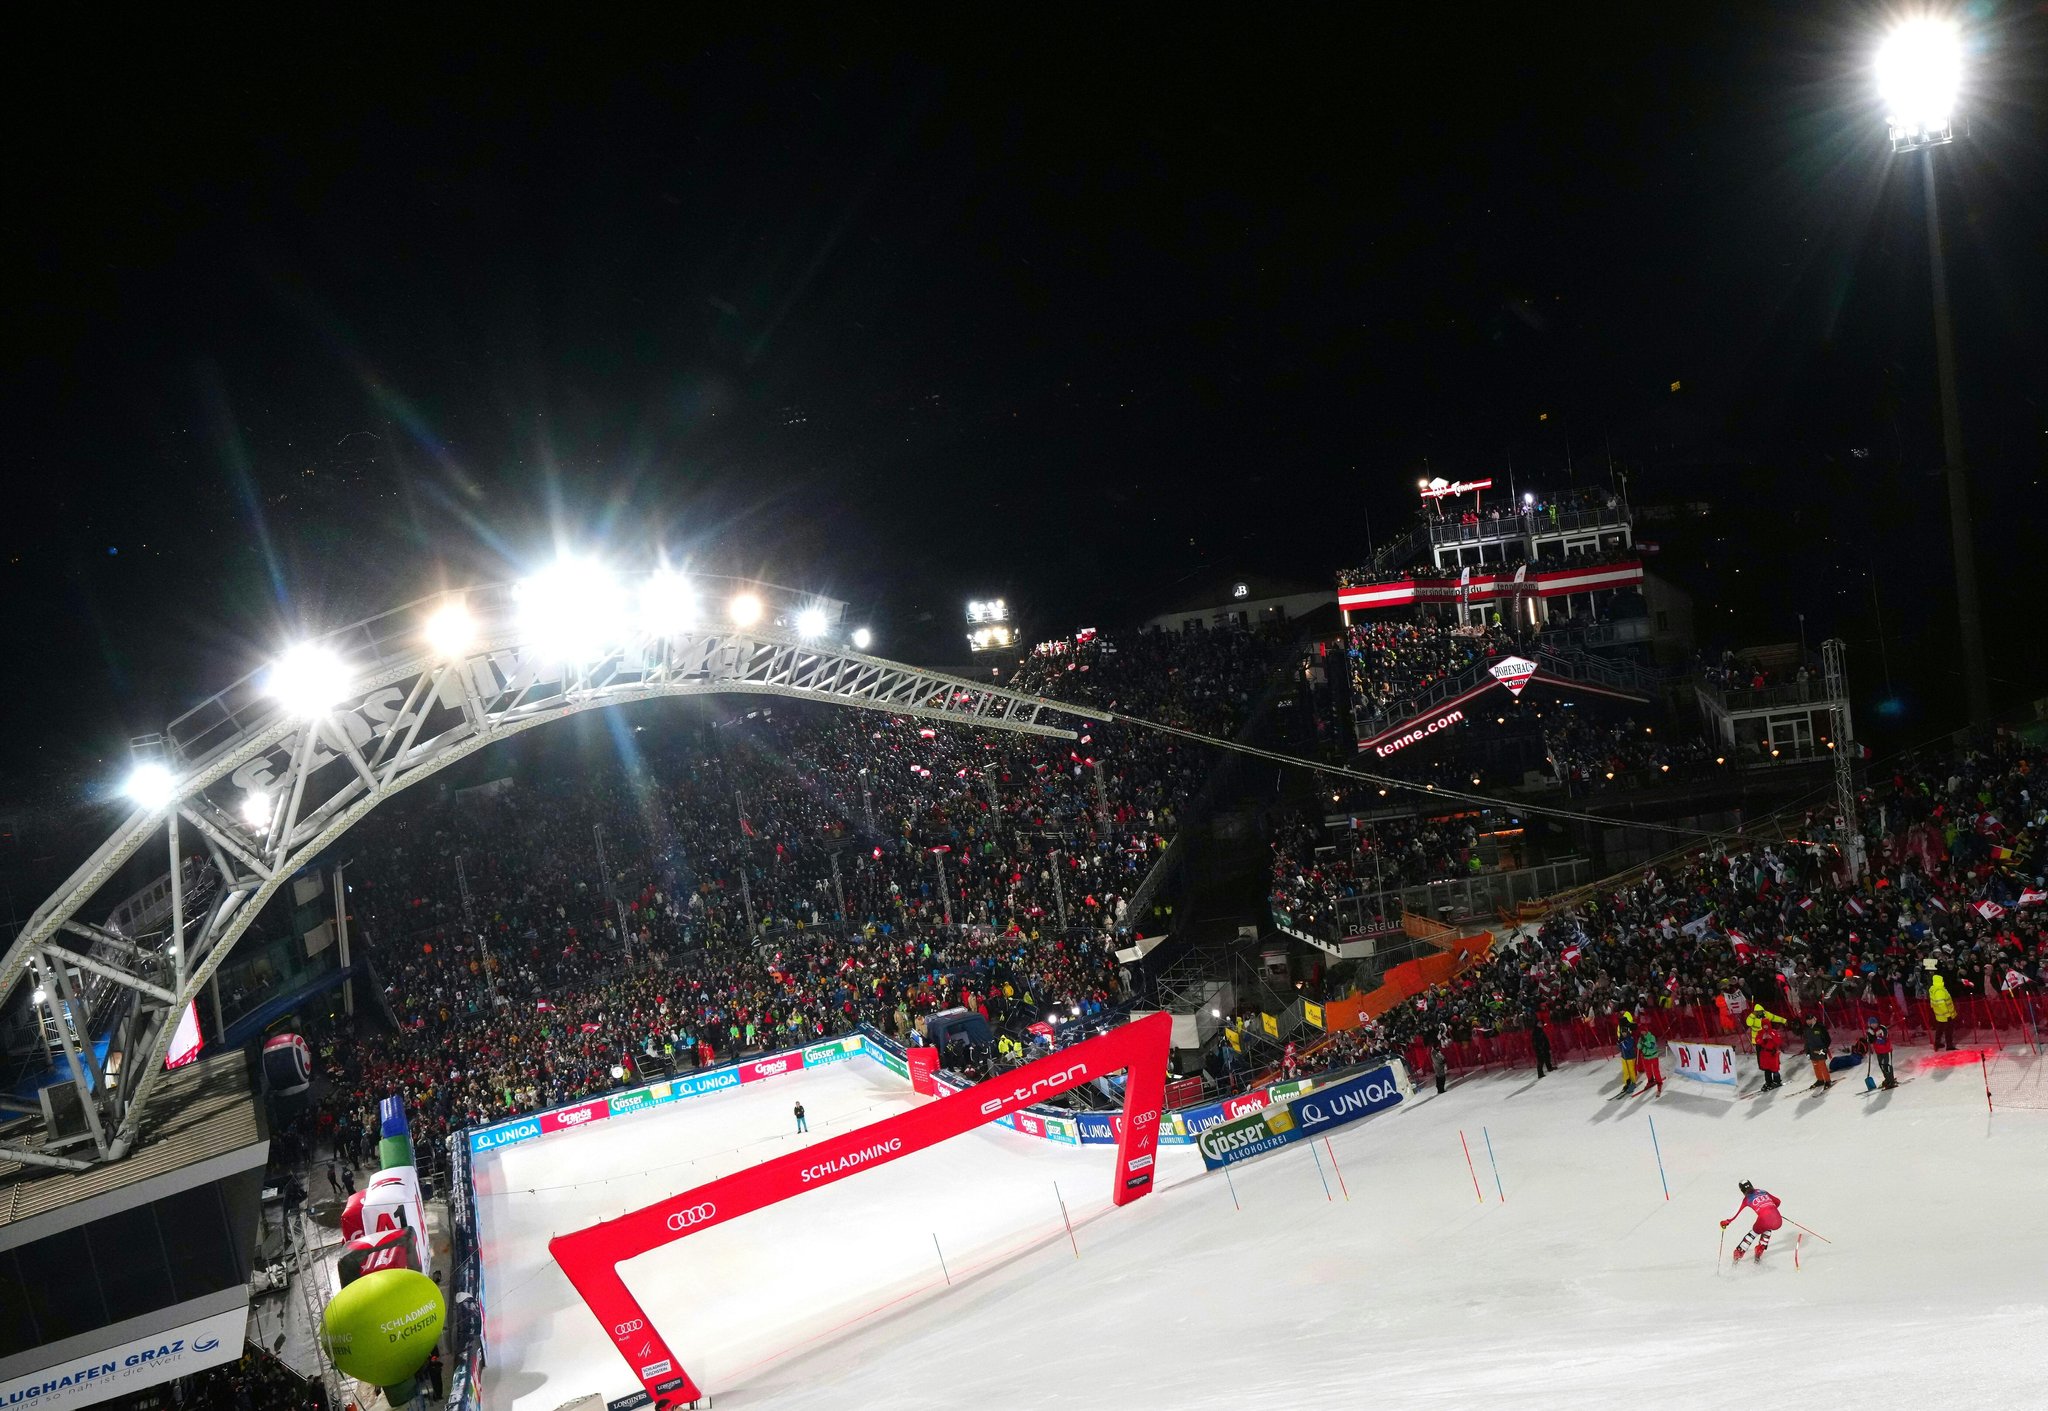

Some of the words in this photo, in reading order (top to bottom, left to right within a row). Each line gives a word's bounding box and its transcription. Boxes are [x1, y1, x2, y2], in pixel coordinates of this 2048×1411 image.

[1494, 661, 1535, 678] HOHENHAUS
[1376, 710, 1464, 758] tenne.com
[697, 1075, 738, 1092] UNIQA
[981, 1062, 1087, 1114] e-tron
[1330, 1079, 1397, 1116] UNIQA
[495, 1124, 539, 1144] UNIQA
[1088, 1124, 1114, 1138] UNIQA
[1200, 1121, 1265, 1160] Gösser
[801, 1137, 902, 1183] SCHLADMING
[1228, 1135, 1287, 1162] ALKOHOLFREI
[380, 1300, 437, 1333] SCHLADMING
[389, 1313, 437, 1343] DACHSTEIN
[0, 1361, 117, 1408] LUGHAFEN
[124, 1339, 185, 1368] GRAZ
[46, 1391, 61, 1403] so
[68, 1381, 93, 1395] nah
[100, 1373, 116, 1386] ist
[123, 1364, 144, 1378] die
[613, 1393, 647, 1409] LONGINES
